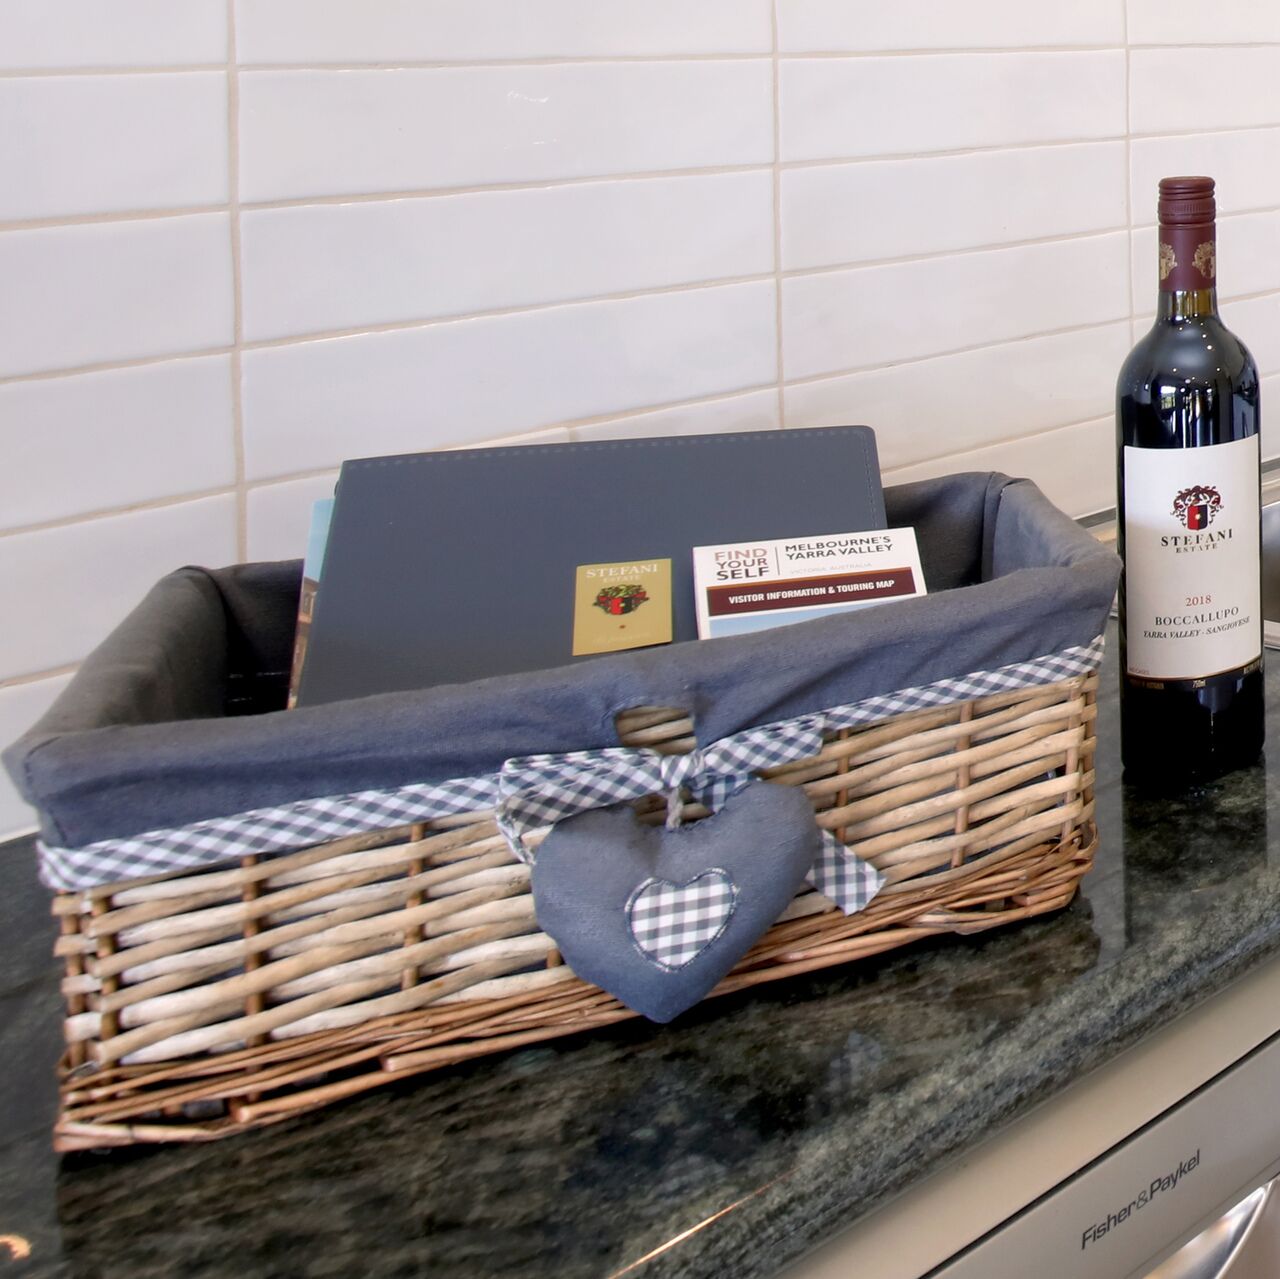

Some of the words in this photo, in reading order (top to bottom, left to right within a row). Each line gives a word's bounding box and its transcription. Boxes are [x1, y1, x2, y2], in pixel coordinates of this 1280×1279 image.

[785, 535, 891, 552] MELBOURNE'S
[1160, 528, 1233, 548] STEFANI
[714, 547, 768, 562] FIND
[786, 548, 836, 561] YARRA
[836, 543, 893, 556] VALLEY
[1175, 543, 1218, 554] ESTATE
[586, 563, 657, 578] STEFANI
[716, 557, 768, 571] YOUR
[716, 566, 770, 581] SELF
[728, 592, 765, 605] VISITOR
[766, 587, 826, 600] INFORMATION
[828, 586, 835, 594] &
[836, 582, 875, 594] TOURING
[876, 579, 895, 589] MAP
[1185, 594, 1212, 607] 2018
[1154, 606, 1240, 626] BOCCALLUPO
[1143, 630, 1168, 639] YARRA
[1169, 628, 1201, 639] VALLEY
[1206, 616, 1250, 635] SANGIOVESE
